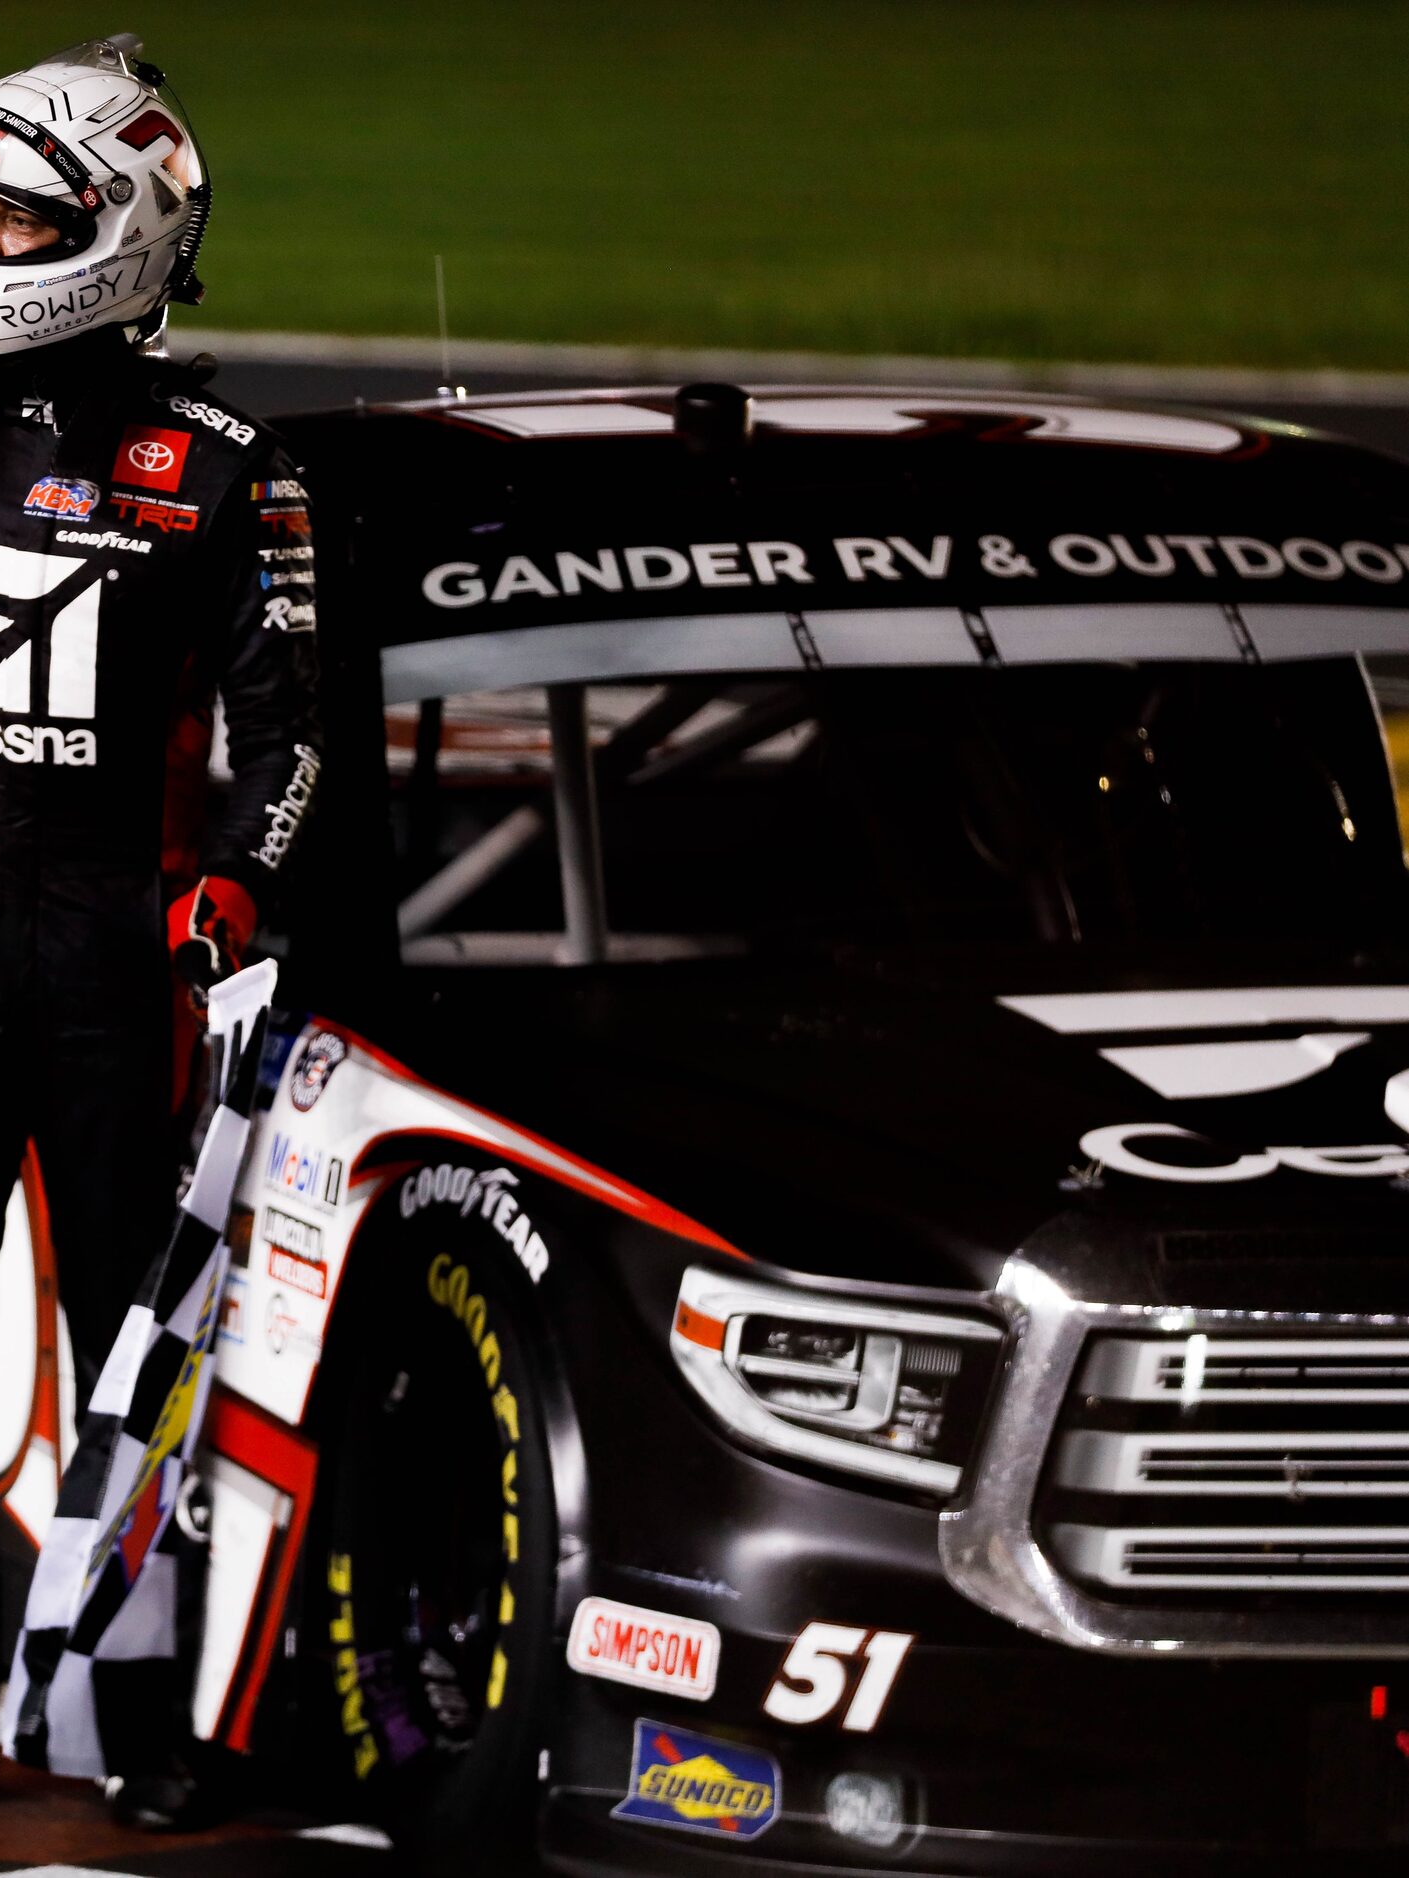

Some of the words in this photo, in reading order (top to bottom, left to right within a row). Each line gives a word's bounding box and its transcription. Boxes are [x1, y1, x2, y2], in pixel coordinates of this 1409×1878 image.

[3, 114, 38, 138] SANITIZER
[55, 151, 81, 178] ROWDY
[33, 312, 93, 336] ENERGY
[23, 483, 93, 517] KBM
[109, 498, 199, 533] TRD
[56, 530, 152, 553] GOODYEAR
[422, 540, 814, 608] GANDER
[832, 535, 954, 580] RV
[978, 535, 1037, 578] &
[325, 1156, 342, 1207] 1
[400, 1163, 550, 1286] GOODYEAR
[588, 1615, 704, 1682] SIMPSON
[763, 1621, 917, 1734] 51
[645, 1768, 770, 1814] SUNOCO
